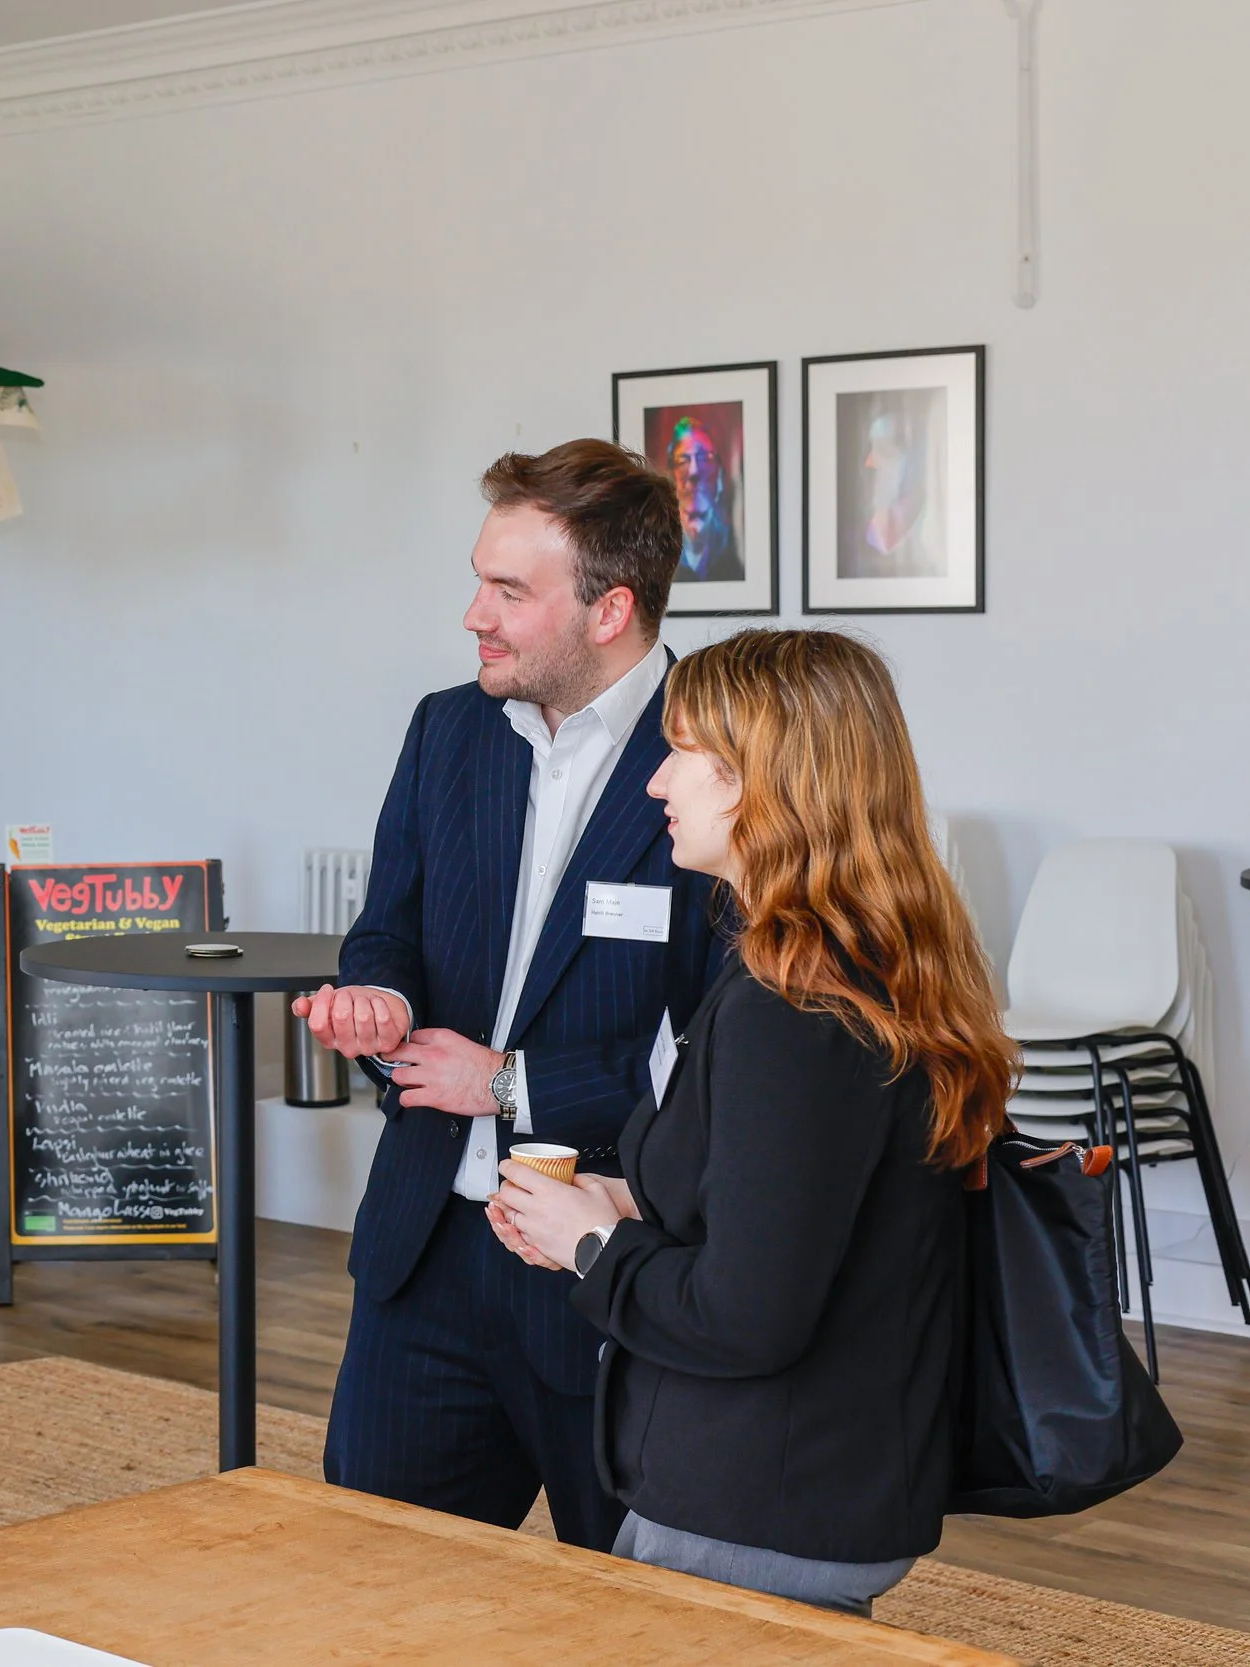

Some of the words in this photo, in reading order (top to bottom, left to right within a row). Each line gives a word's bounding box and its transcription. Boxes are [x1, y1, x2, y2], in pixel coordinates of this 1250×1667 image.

[28, 873, 184, 915] VegTubby
[35, 918, 116, 931] Vegetarian
[118, 917, 133, 929] &
[134, 916, 180, 930] Vegan
[28, 1060, 89, 1078] Masala
[58, 1201, 111, 1221] Mango
